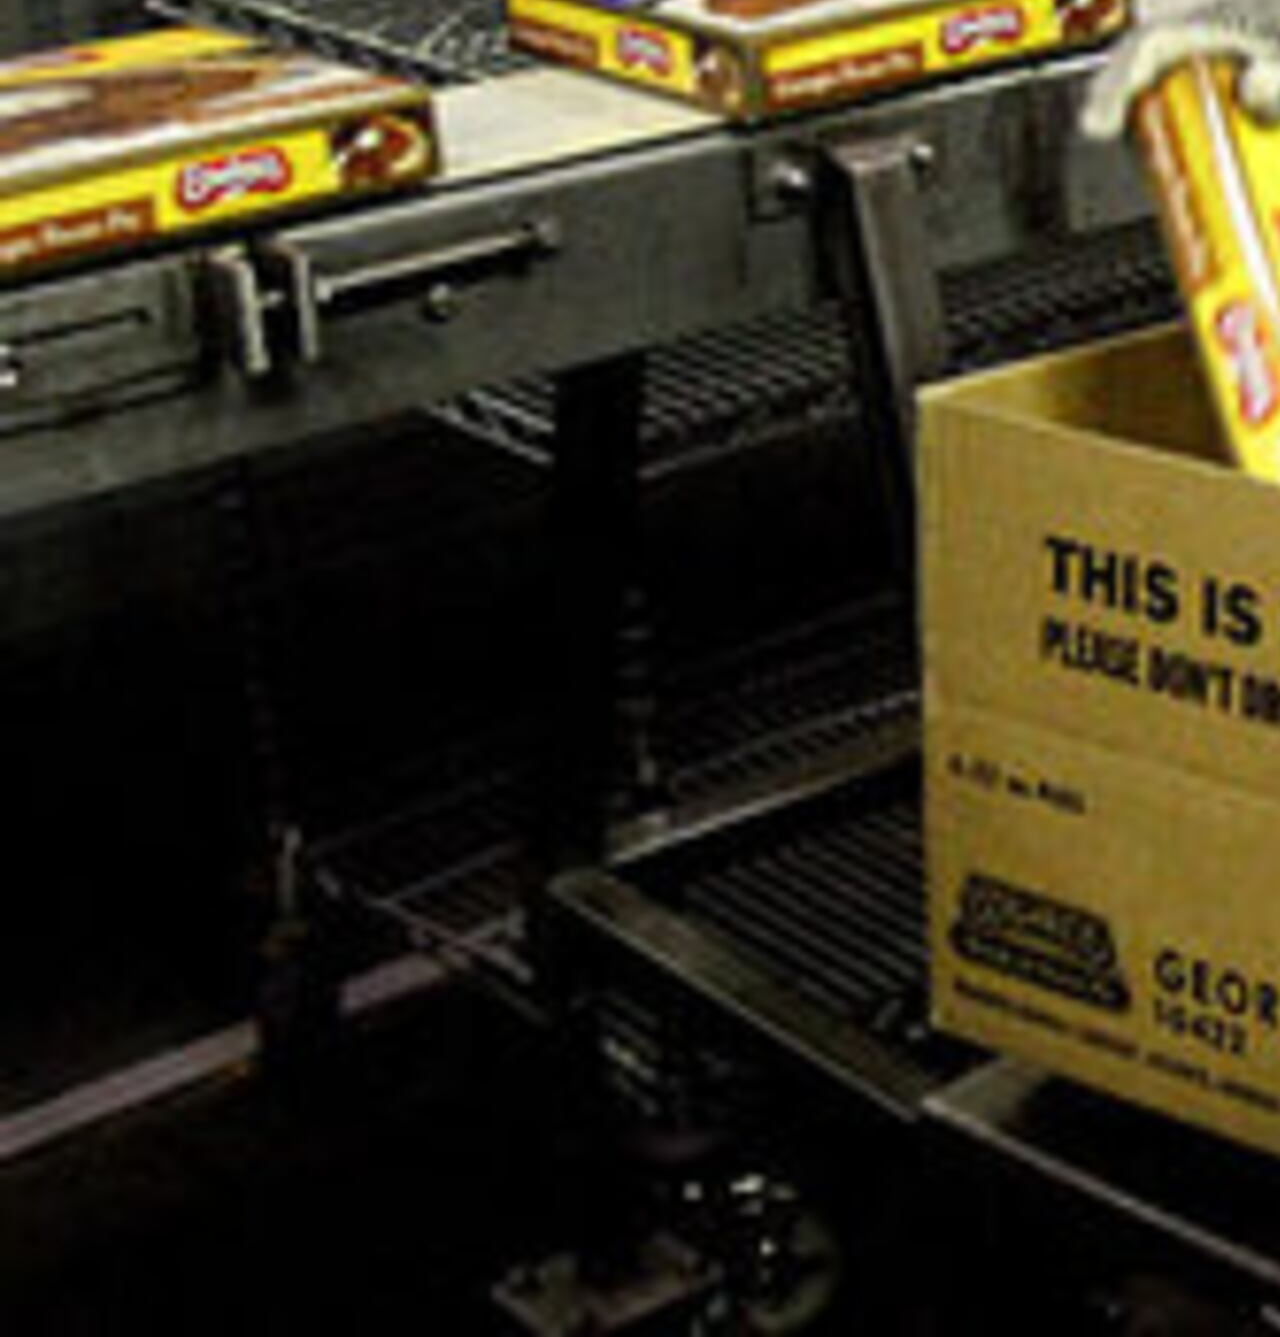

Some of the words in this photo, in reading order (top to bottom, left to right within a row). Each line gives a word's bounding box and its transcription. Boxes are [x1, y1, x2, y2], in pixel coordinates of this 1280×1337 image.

[1045, 535, 1179, 624] THIS
[1203, 576, 1263, 647] IS
[1042, 615, 1140, 687] PLEASE
